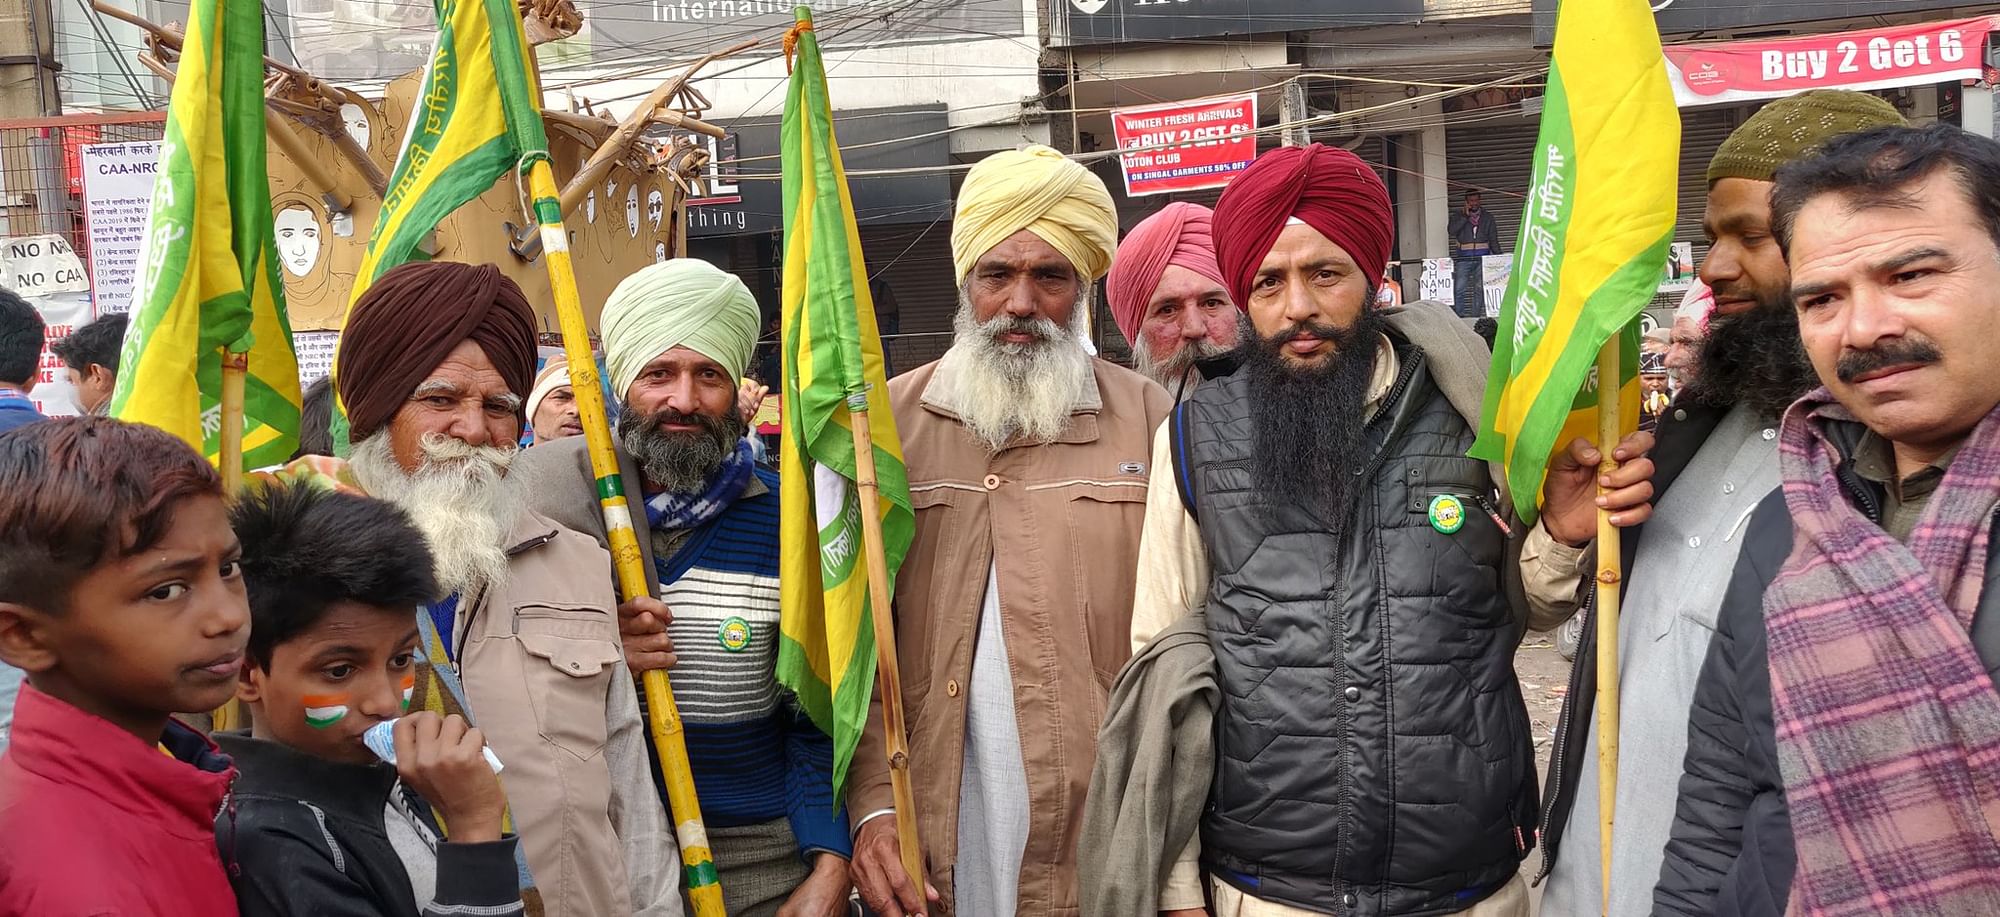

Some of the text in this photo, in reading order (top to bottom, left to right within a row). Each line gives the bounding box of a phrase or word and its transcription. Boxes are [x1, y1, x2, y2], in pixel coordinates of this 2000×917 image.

[652, 0, 835, 21] Internatioa
[1761, 50, 1827, 81] Buy
[1837, 41, 1859, 73] 2
[1868, 35, 1931, 70] Get
[1125, 108, 1243, 130] WINTER FRESH ARRIVALS
[1141, 132, 1176, 153] BUY
[1180, 129, 1192, 149] 2
[1194, 126, 1227, 147] GET
[88, 142, 153, 158] मेहरबानी करके
[1155, 153, 1181, 165] CLUB
[1131, 173, 1142, 181] ON
[1173, 165, 1213, 176] GARMENTS
[1232, 161, 1246, 170] OFF
[11, 243, 40, 258] NO
[18, 268, 83, 288] NO CAA
[1421, 278, 1451, 289] NAMO
